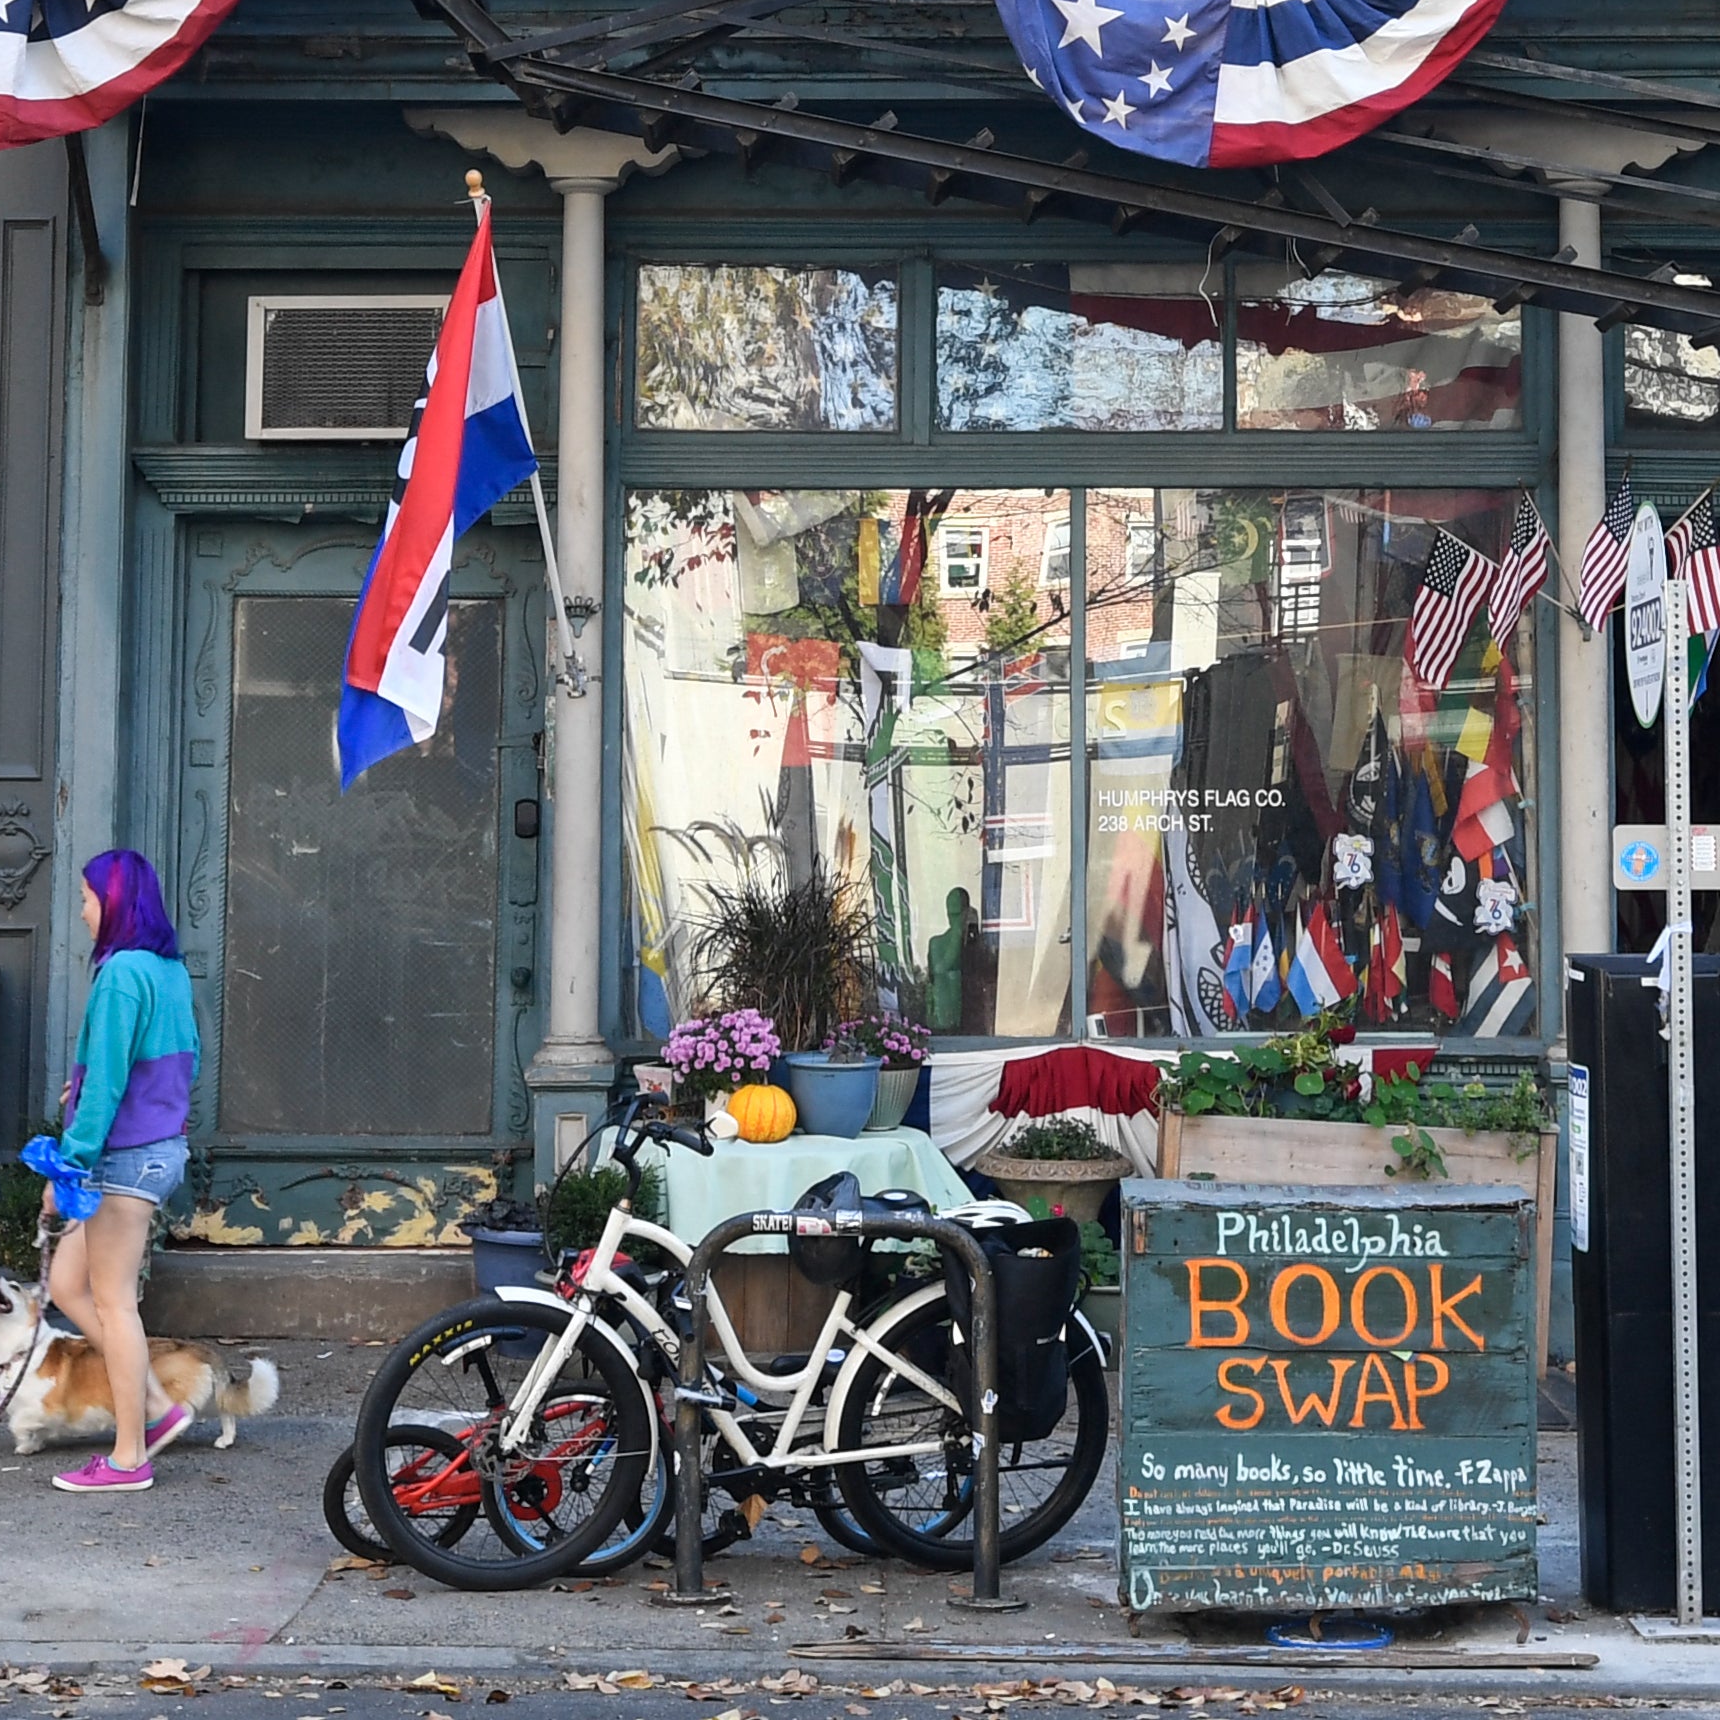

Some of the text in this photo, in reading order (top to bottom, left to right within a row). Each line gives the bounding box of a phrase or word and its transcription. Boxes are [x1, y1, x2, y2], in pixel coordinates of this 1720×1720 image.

[1098, 788, 1287, 807] HUMPHRYS FLAG CO.
[1098, 814, 1214, 832] 238 ARCH ST.
[752, 1214, 793, 1231] SKATE!
[1216, 1211, 1449, 1273] Philadelphia
[1183, 1258, 1485, 1352] BOOK
[1214, 1352, 1450, 1430] SWAP
[1141, 1452, 1166, 1481] So
[1174, 1462, 1229, 1487] many
[1236, 1452, 1299, 1485] books,
[1302, 1464, 1327, 1483] so
[1333, 1457, 1387, 1486] little
[1392, 1454, 1452, 1489] time.
[1123, 1498, 1140, 1516] I
[1144, 1499, 1172, 1516] have
